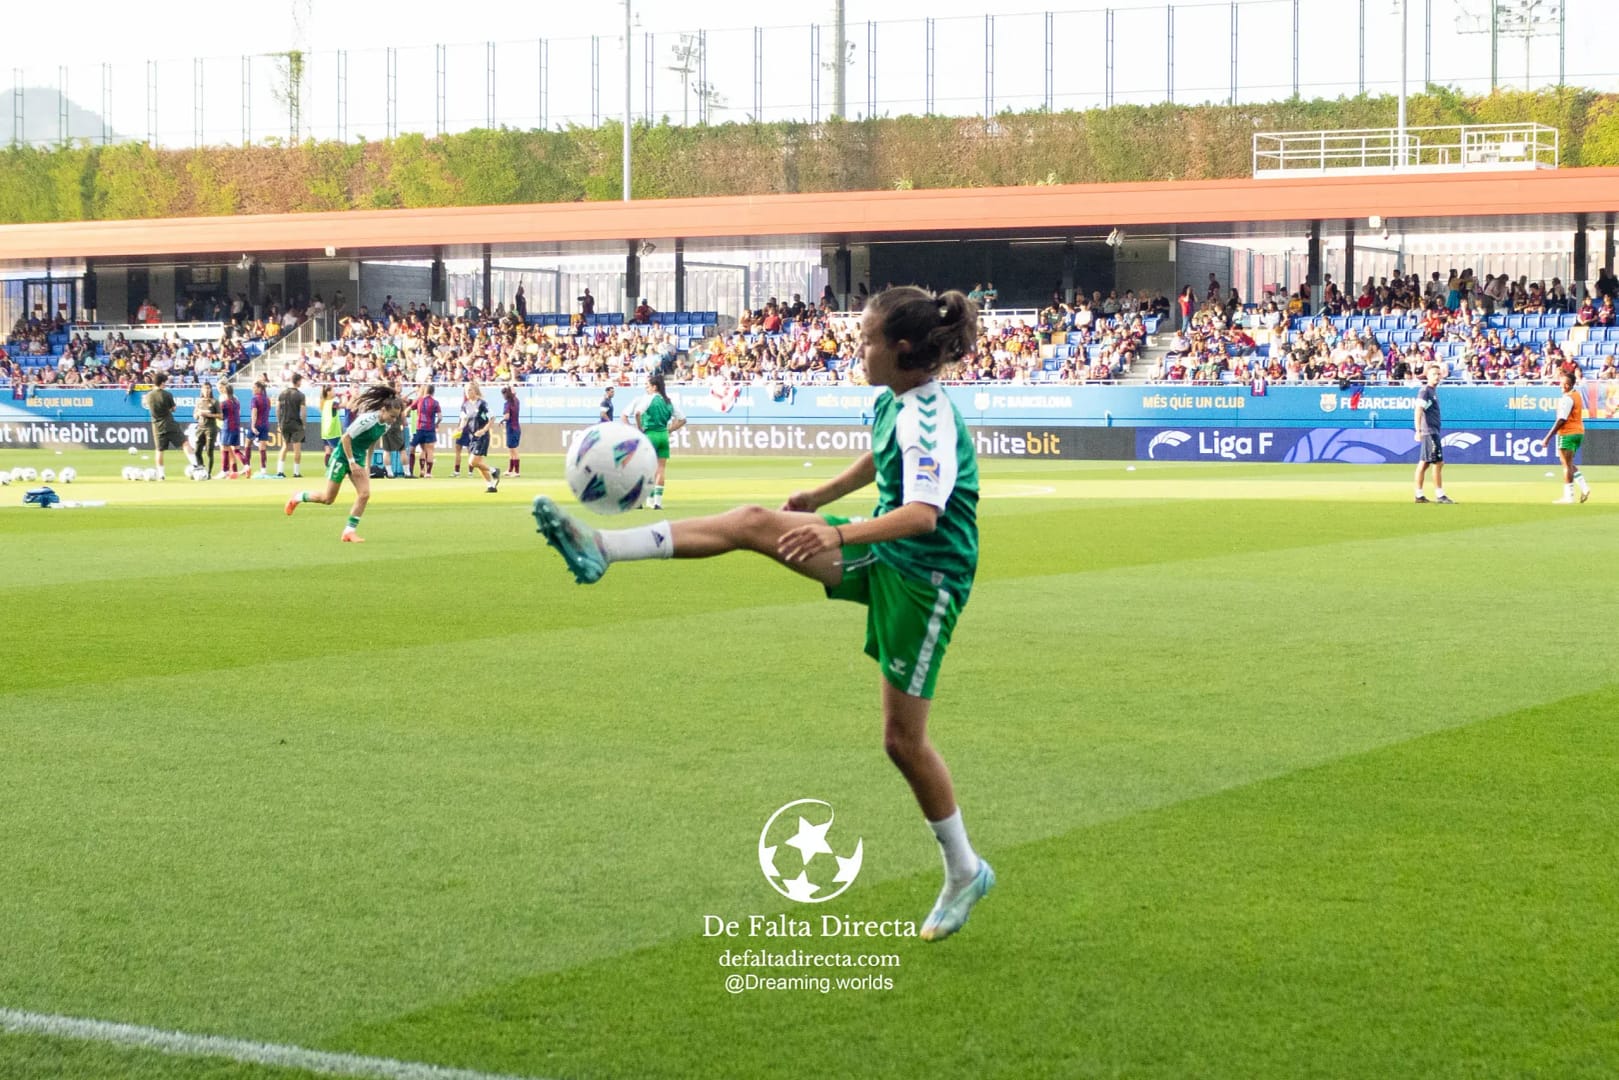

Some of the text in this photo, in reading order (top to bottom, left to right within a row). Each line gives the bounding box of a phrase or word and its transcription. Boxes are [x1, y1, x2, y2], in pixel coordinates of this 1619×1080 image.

[1142, 394, 1245, 410] MÉS QUE UN CLUB
[1509, 395, 1559, 411] MÉS QU
[0, 423, 149, 443] t whitebit.com
[670, 425, 872, 450] at whitebit.com
[971, 431, 1061, 455] hitebit
[1198, 430, 1274, 459] Liga F
[1489, 432, 1548, 462] Liga
